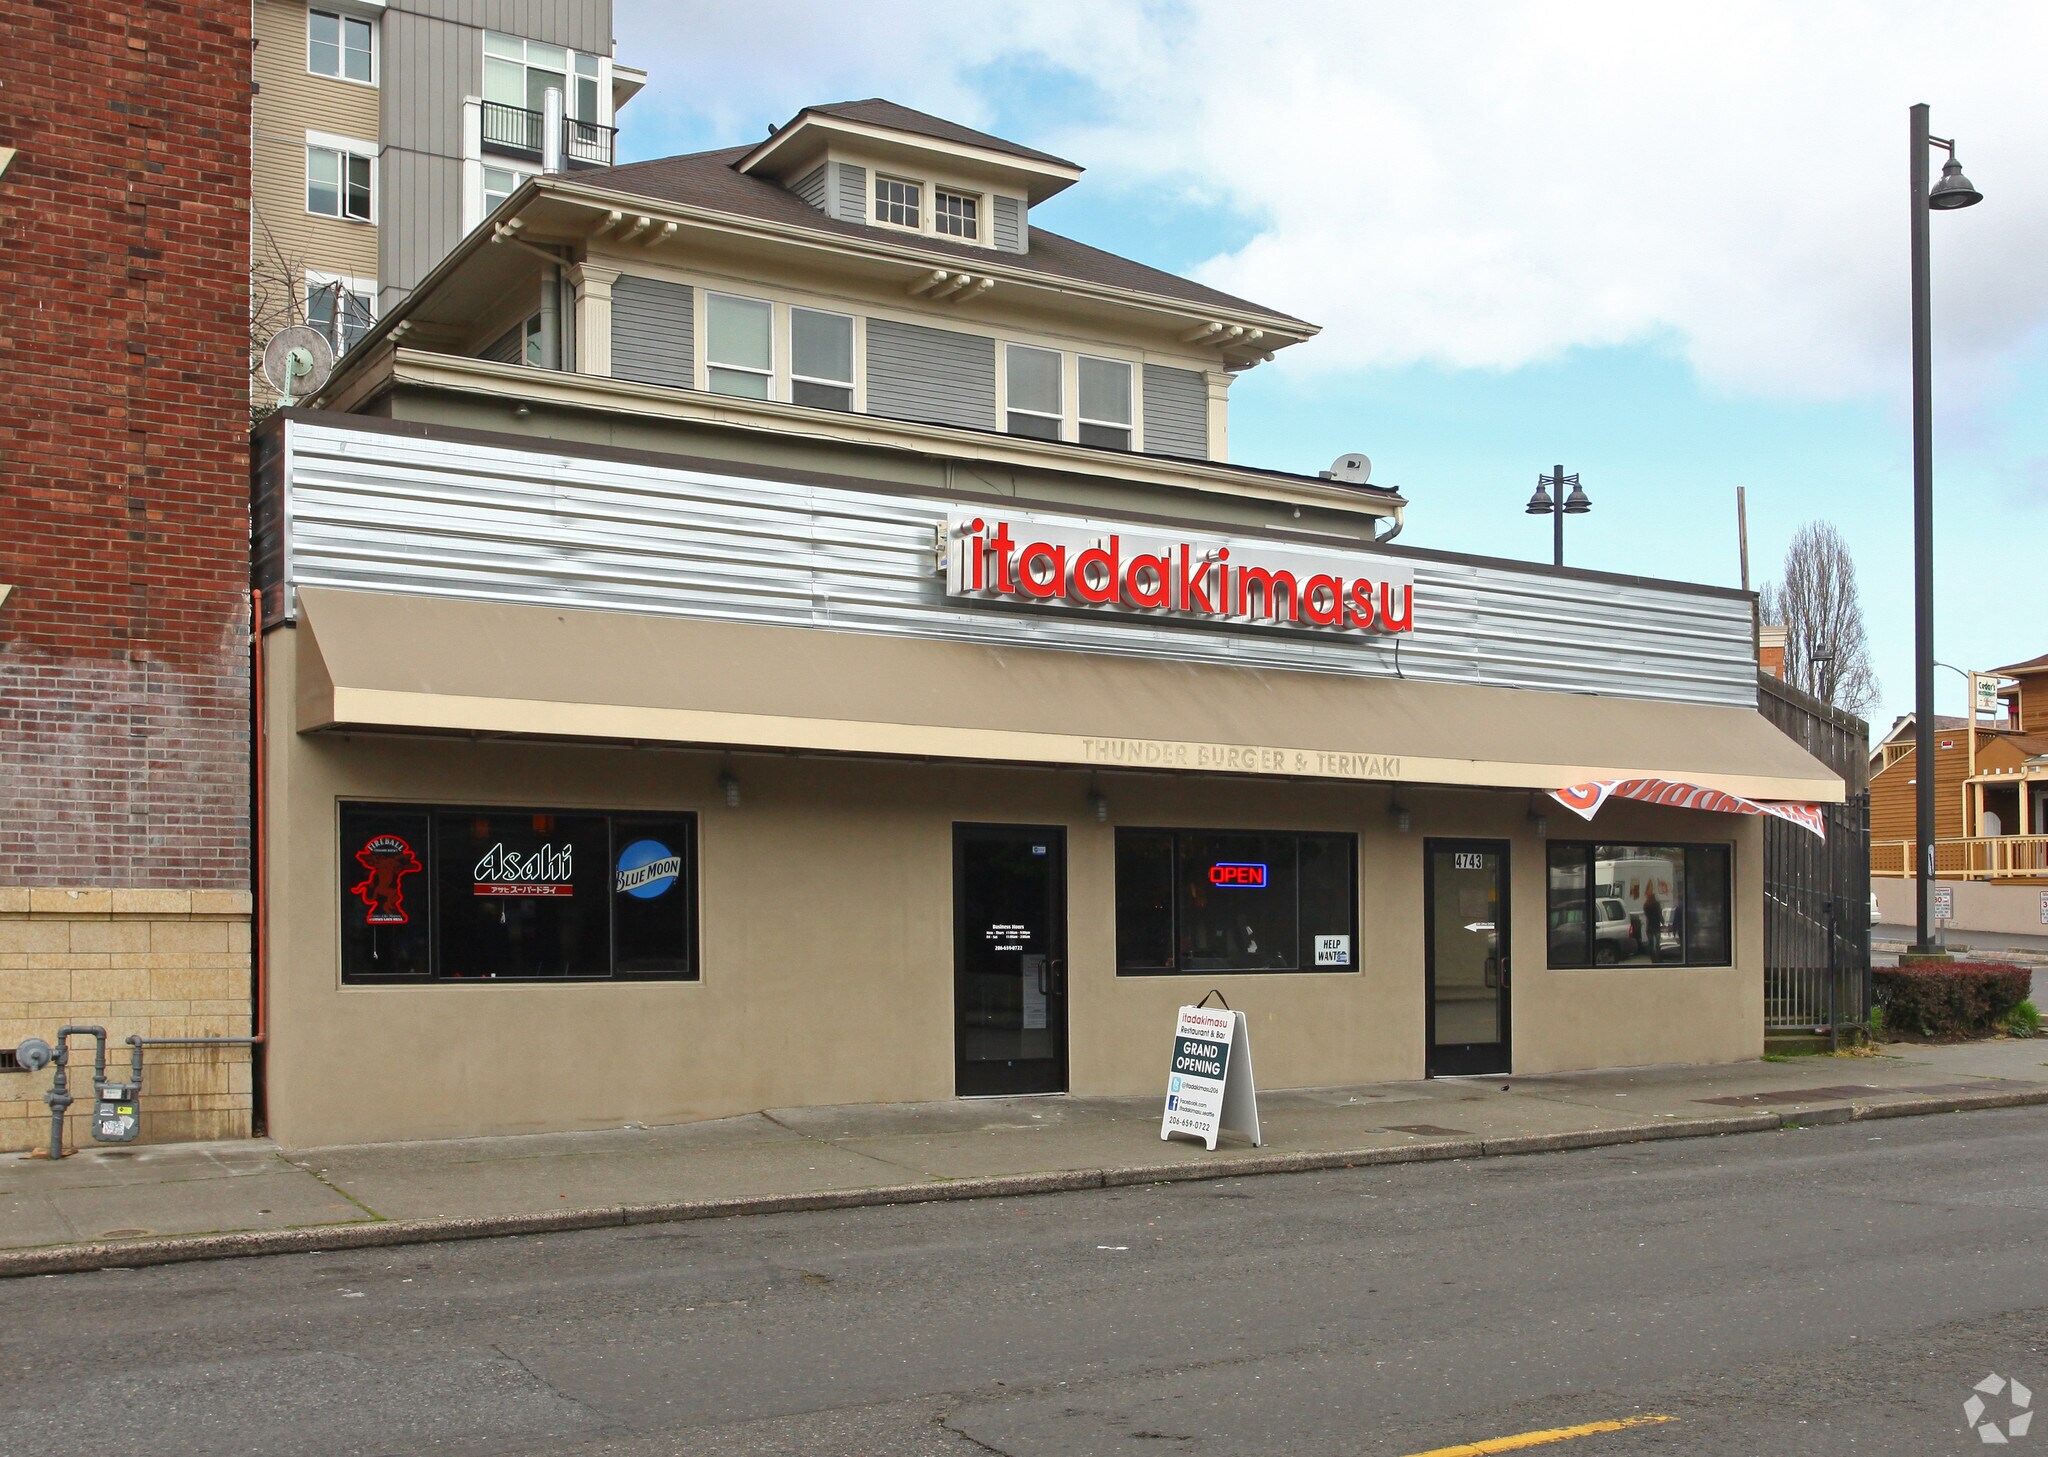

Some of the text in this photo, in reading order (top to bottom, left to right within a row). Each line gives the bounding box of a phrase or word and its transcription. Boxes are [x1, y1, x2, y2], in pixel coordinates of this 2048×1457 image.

[970, 517, 1413, 632] itadakimasu
[1082, 739, 1401, 778] THUNDER BURGER & TERIYAKI
[368, 838, 404, 852] FIREBALL
[474, 842, 573, 881] Asahi
[1456, 854, 1482, 868] 4743
[617, 860, 679, 891] BLUE MOON
[1210, 866, 1263, 884] OPEN
[1323, 939, 1341, 949] HELP
[1182, 1013, 1228, 1028] itadakimasu
[1181, 1025, 1226, 1040] Restaurant & Bar
[1183, 1041, 1218, 1058] GRAND
[1176, 1056, 1220, 1075] OPENING
[1168, 1115, 1211, 1132] 206-659-0722
